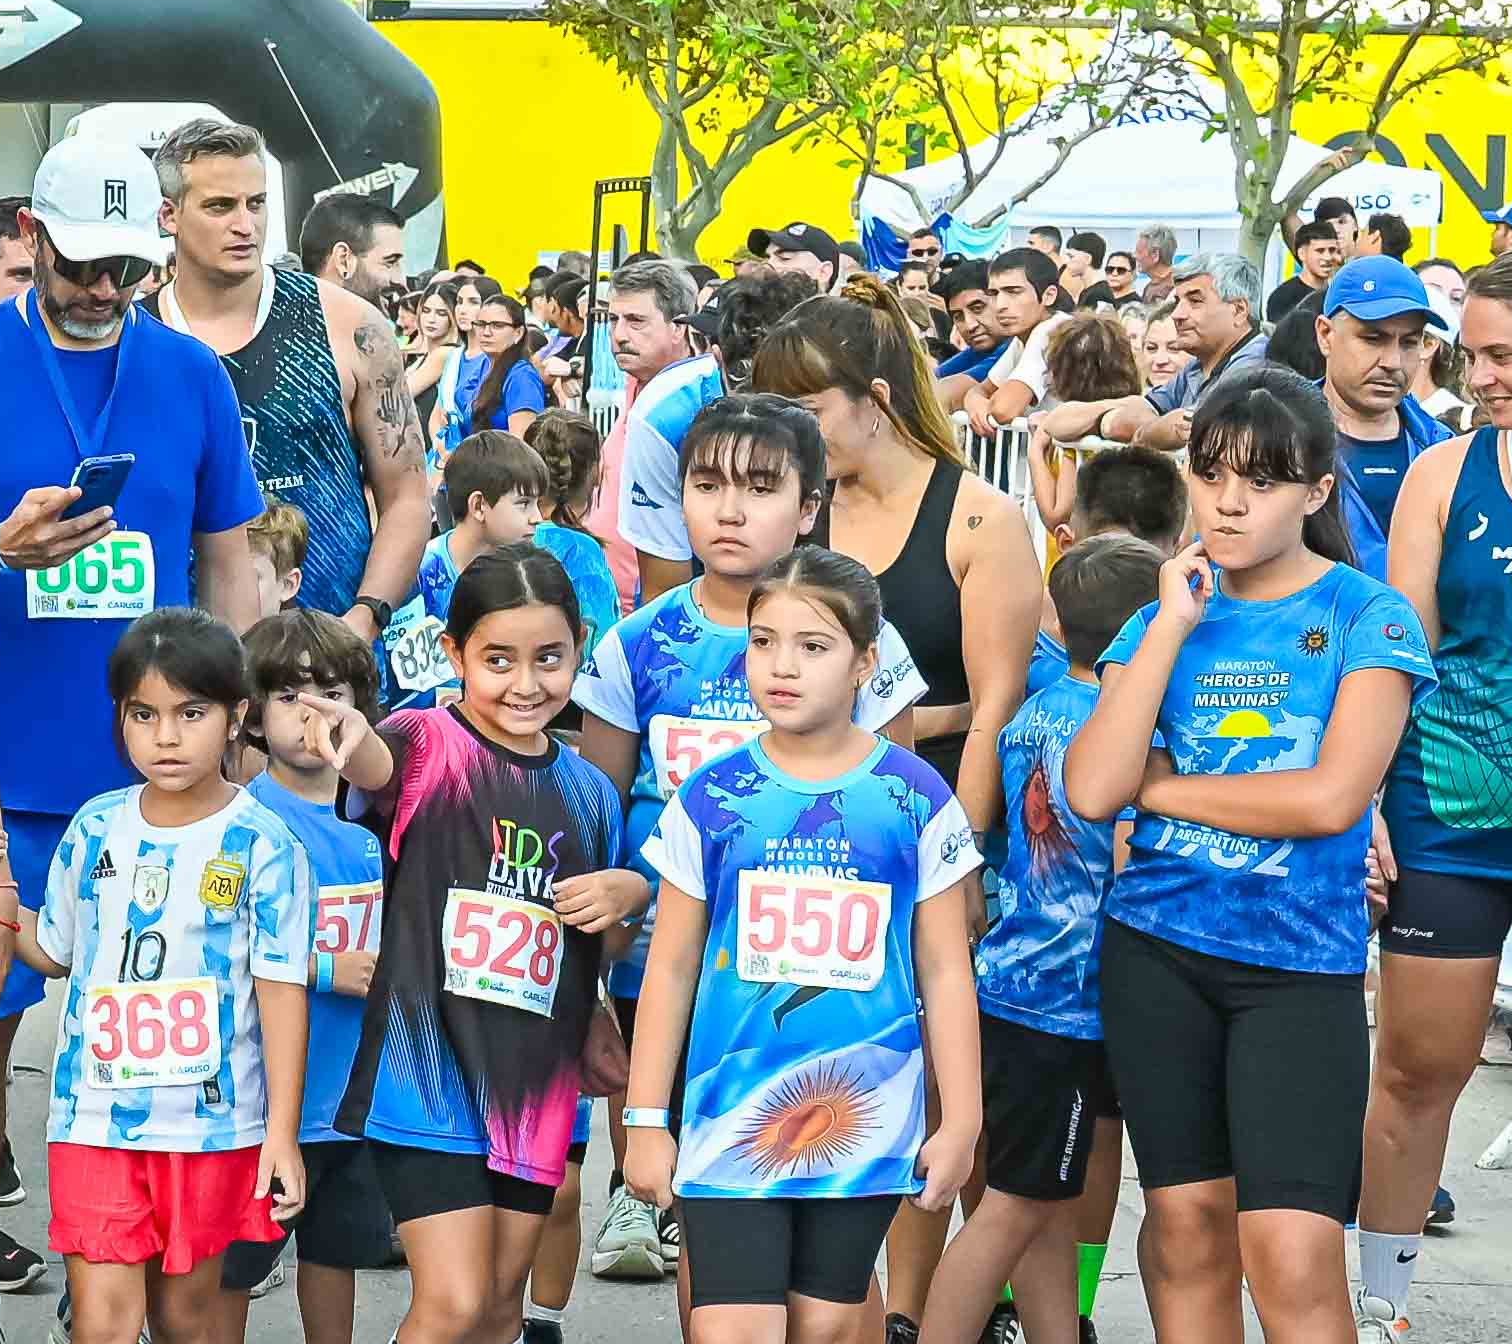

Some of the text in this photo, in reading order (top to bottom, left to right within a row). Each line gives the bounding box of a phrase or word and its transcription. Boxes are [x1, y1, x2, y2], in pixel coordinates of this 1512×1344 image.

[1300, 194, 1391, 213] CUSO
[267, 474, 305, 491] TEAM
[1267, 673, 1289, 686] DE
[1026, 710, 1077, 736] ISLAS
[766, 836, 850, 852] MARATÓN
[1174, 827, 1259, 856] ARGENTINA
[831, 853, 849, 864] DE
[316, 892, 382, 954] 57
[749, 885, 879, 961] 550
[118, 928, 167, 983] 10
[450, 902, 559, 987] 528
[91, 988, 210, 1062] 368
